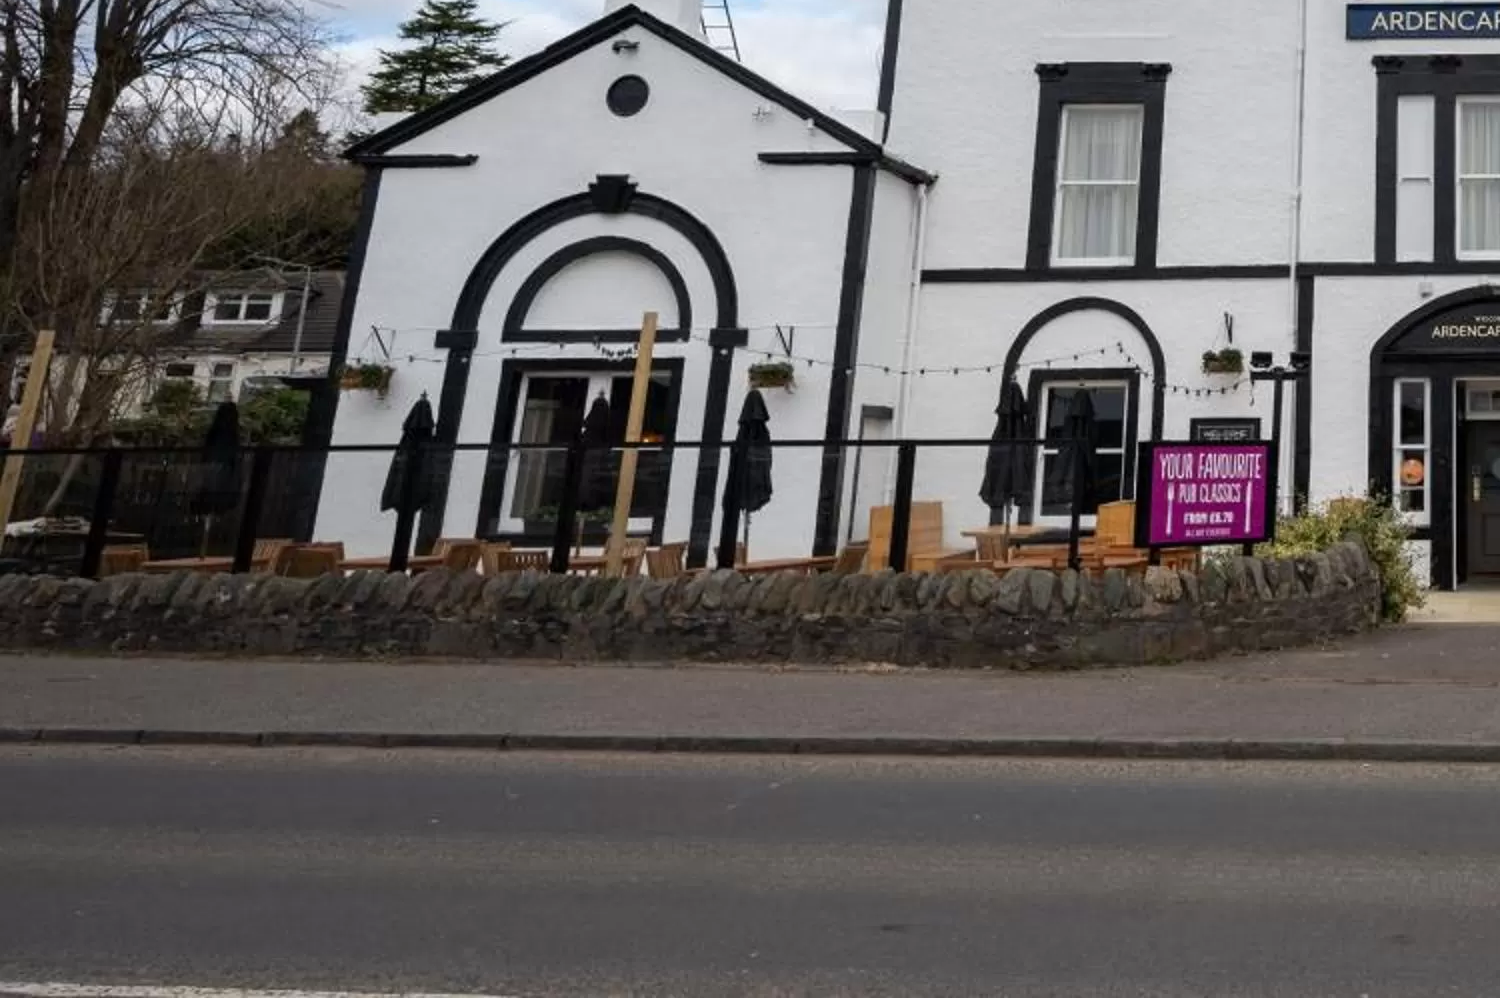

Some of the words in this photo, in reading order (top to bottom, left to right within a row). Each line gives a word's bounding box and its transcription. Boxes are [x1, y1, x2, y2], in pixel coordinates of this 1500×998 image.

[1160, 452, 1194, 480] YOUR
[1198, 452, 1262, 479] FAVOURITE
[1178, 483, 1197, 503] PUB
[1199, 483, 1241, 503] CLASSICS
[1183, 512, 1207, 524] FROM
